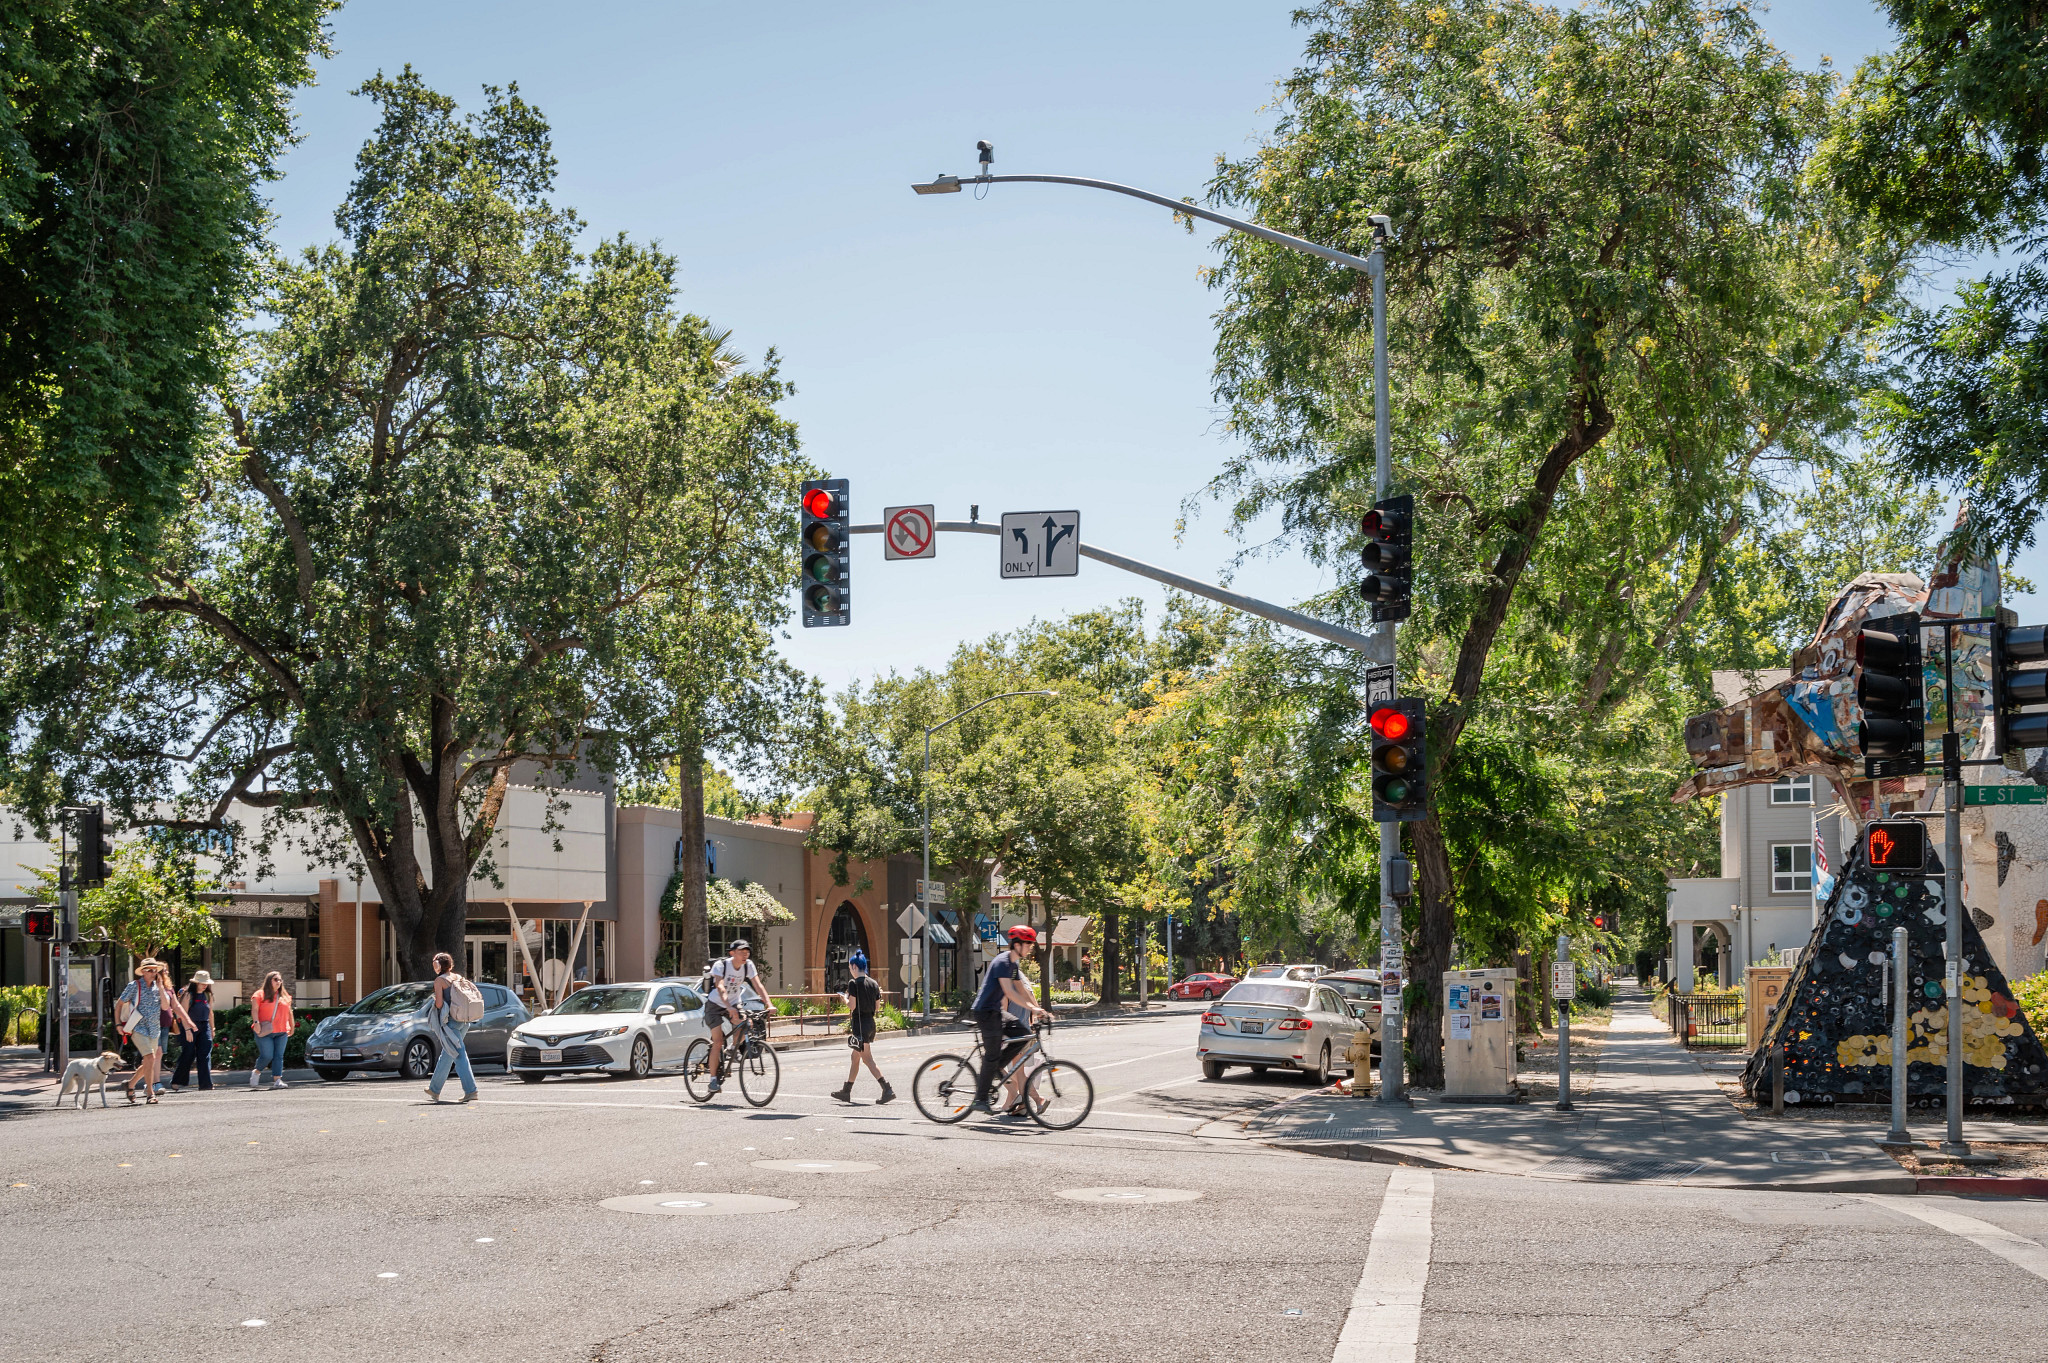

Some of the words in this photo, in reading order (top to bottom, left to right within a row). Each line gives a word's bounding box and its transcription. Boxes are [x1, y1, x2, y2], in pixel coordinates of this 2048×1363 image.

[1005, 561, 1034, 573] ONLY
[1367, 668, 1393, 679] HISTORIC
[1373, 690, 1388, 702] 40
[1978, 787, 1987, 802] E
[1997, 787, 2016, 802] ST
[2033, 785, 2046, 793] 100
[987, 924, 997, 937] P
